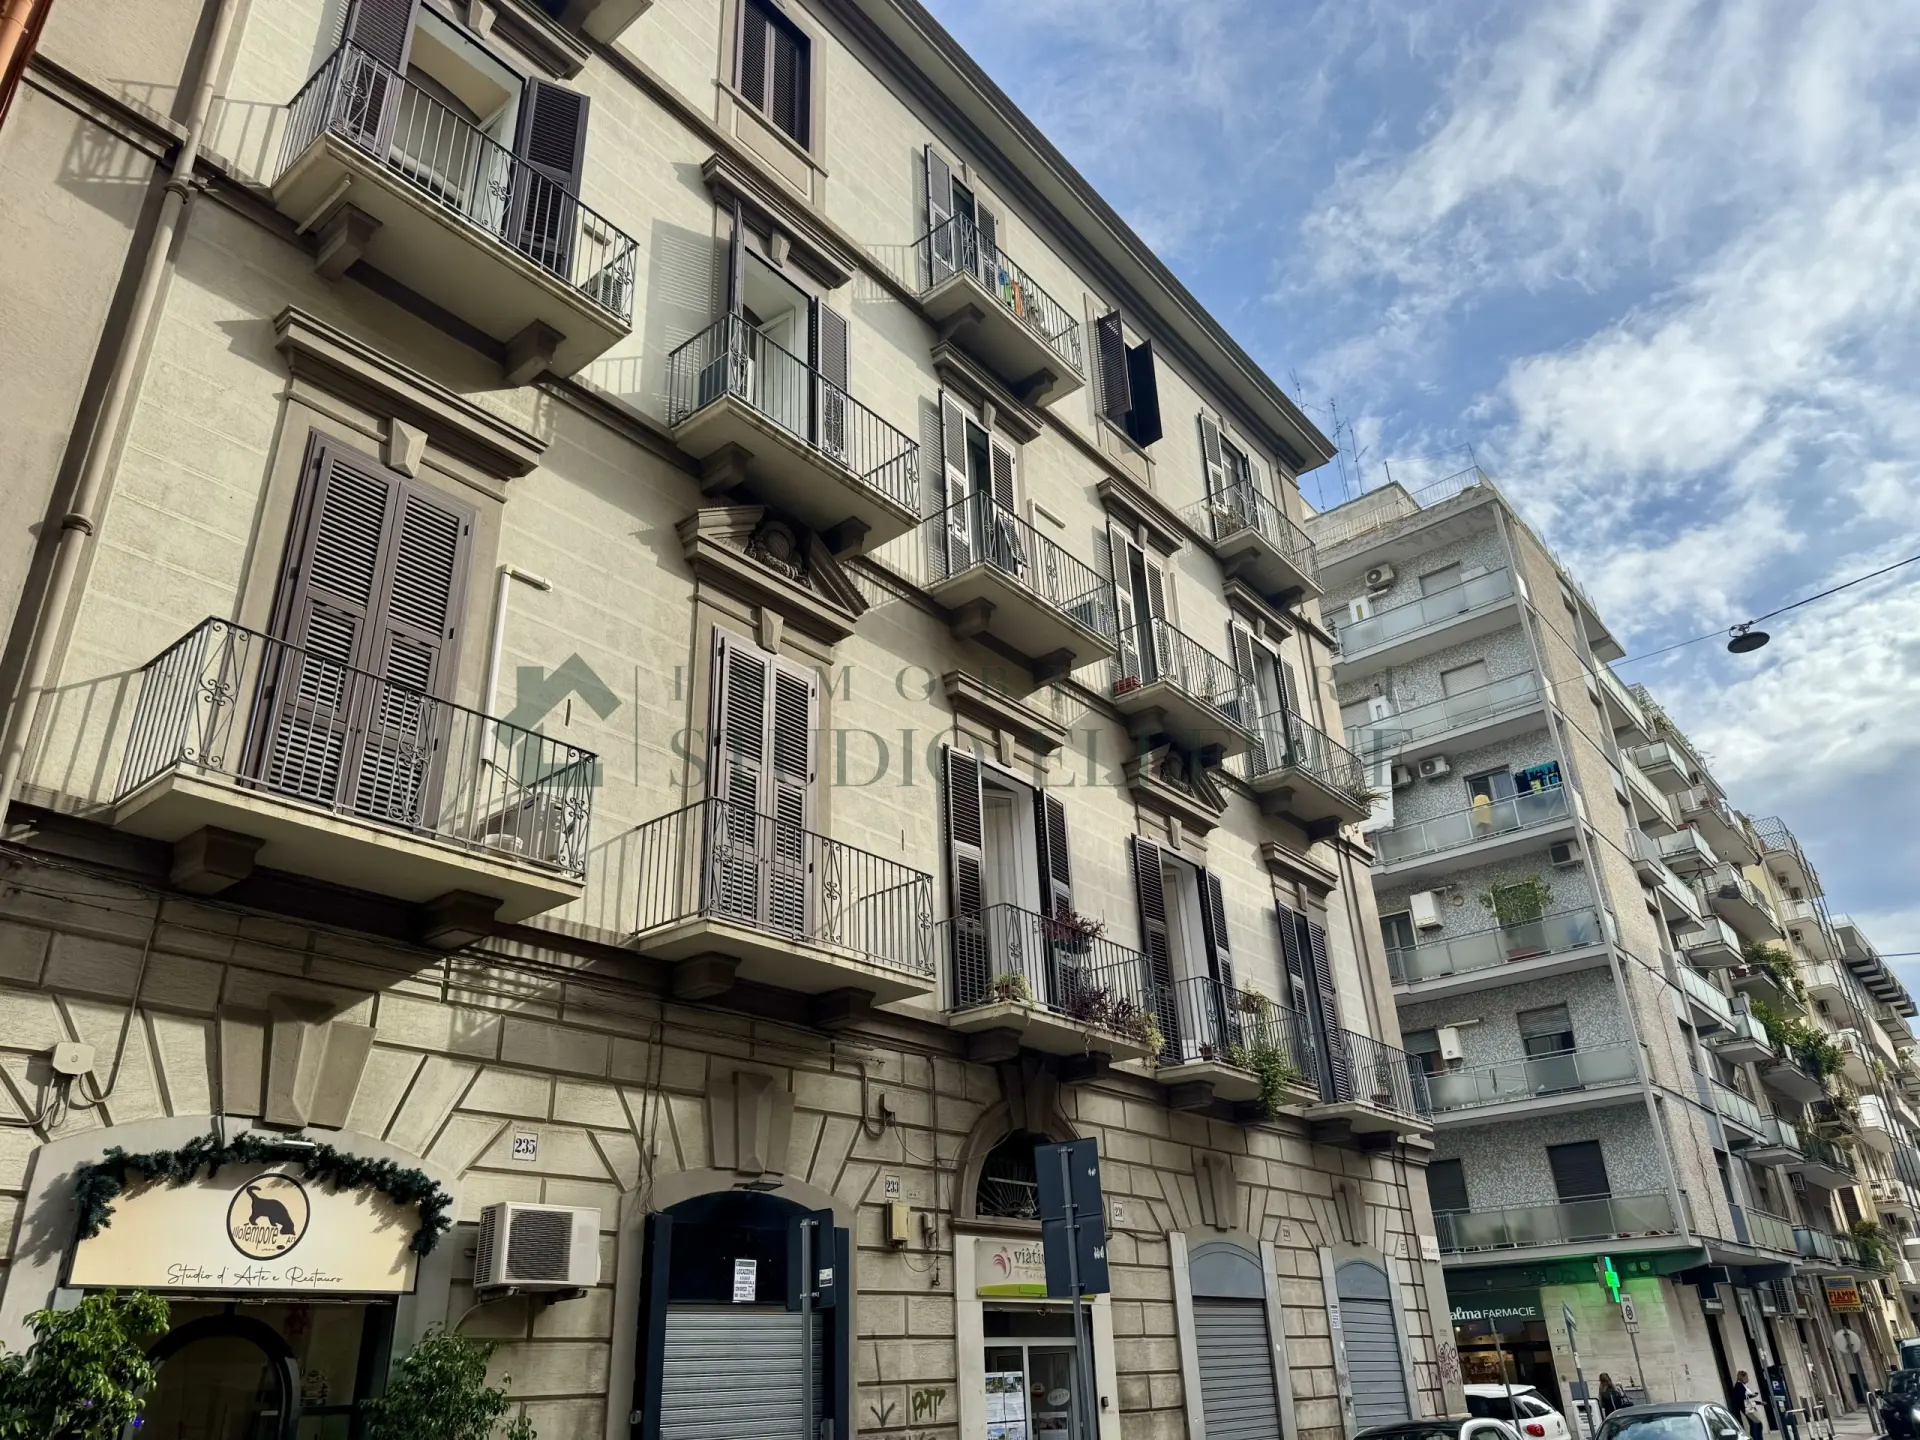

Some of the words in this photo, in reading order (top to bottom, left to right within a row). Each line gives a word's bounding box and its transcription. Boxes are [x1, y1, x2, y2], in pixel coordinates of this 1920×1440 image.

[515, 1138, 536, 1154] 235
[886, 1180, 899, 1193] 233
[167, 1263, 213, 1285] Studio
[233, 1265, 271, 1286] Arte
[285, 1266, 343, 1288] Restauro
[1482, 1306, 1536, 1319] FARMACIE
[1772, 1380, 1780, 1389] P
